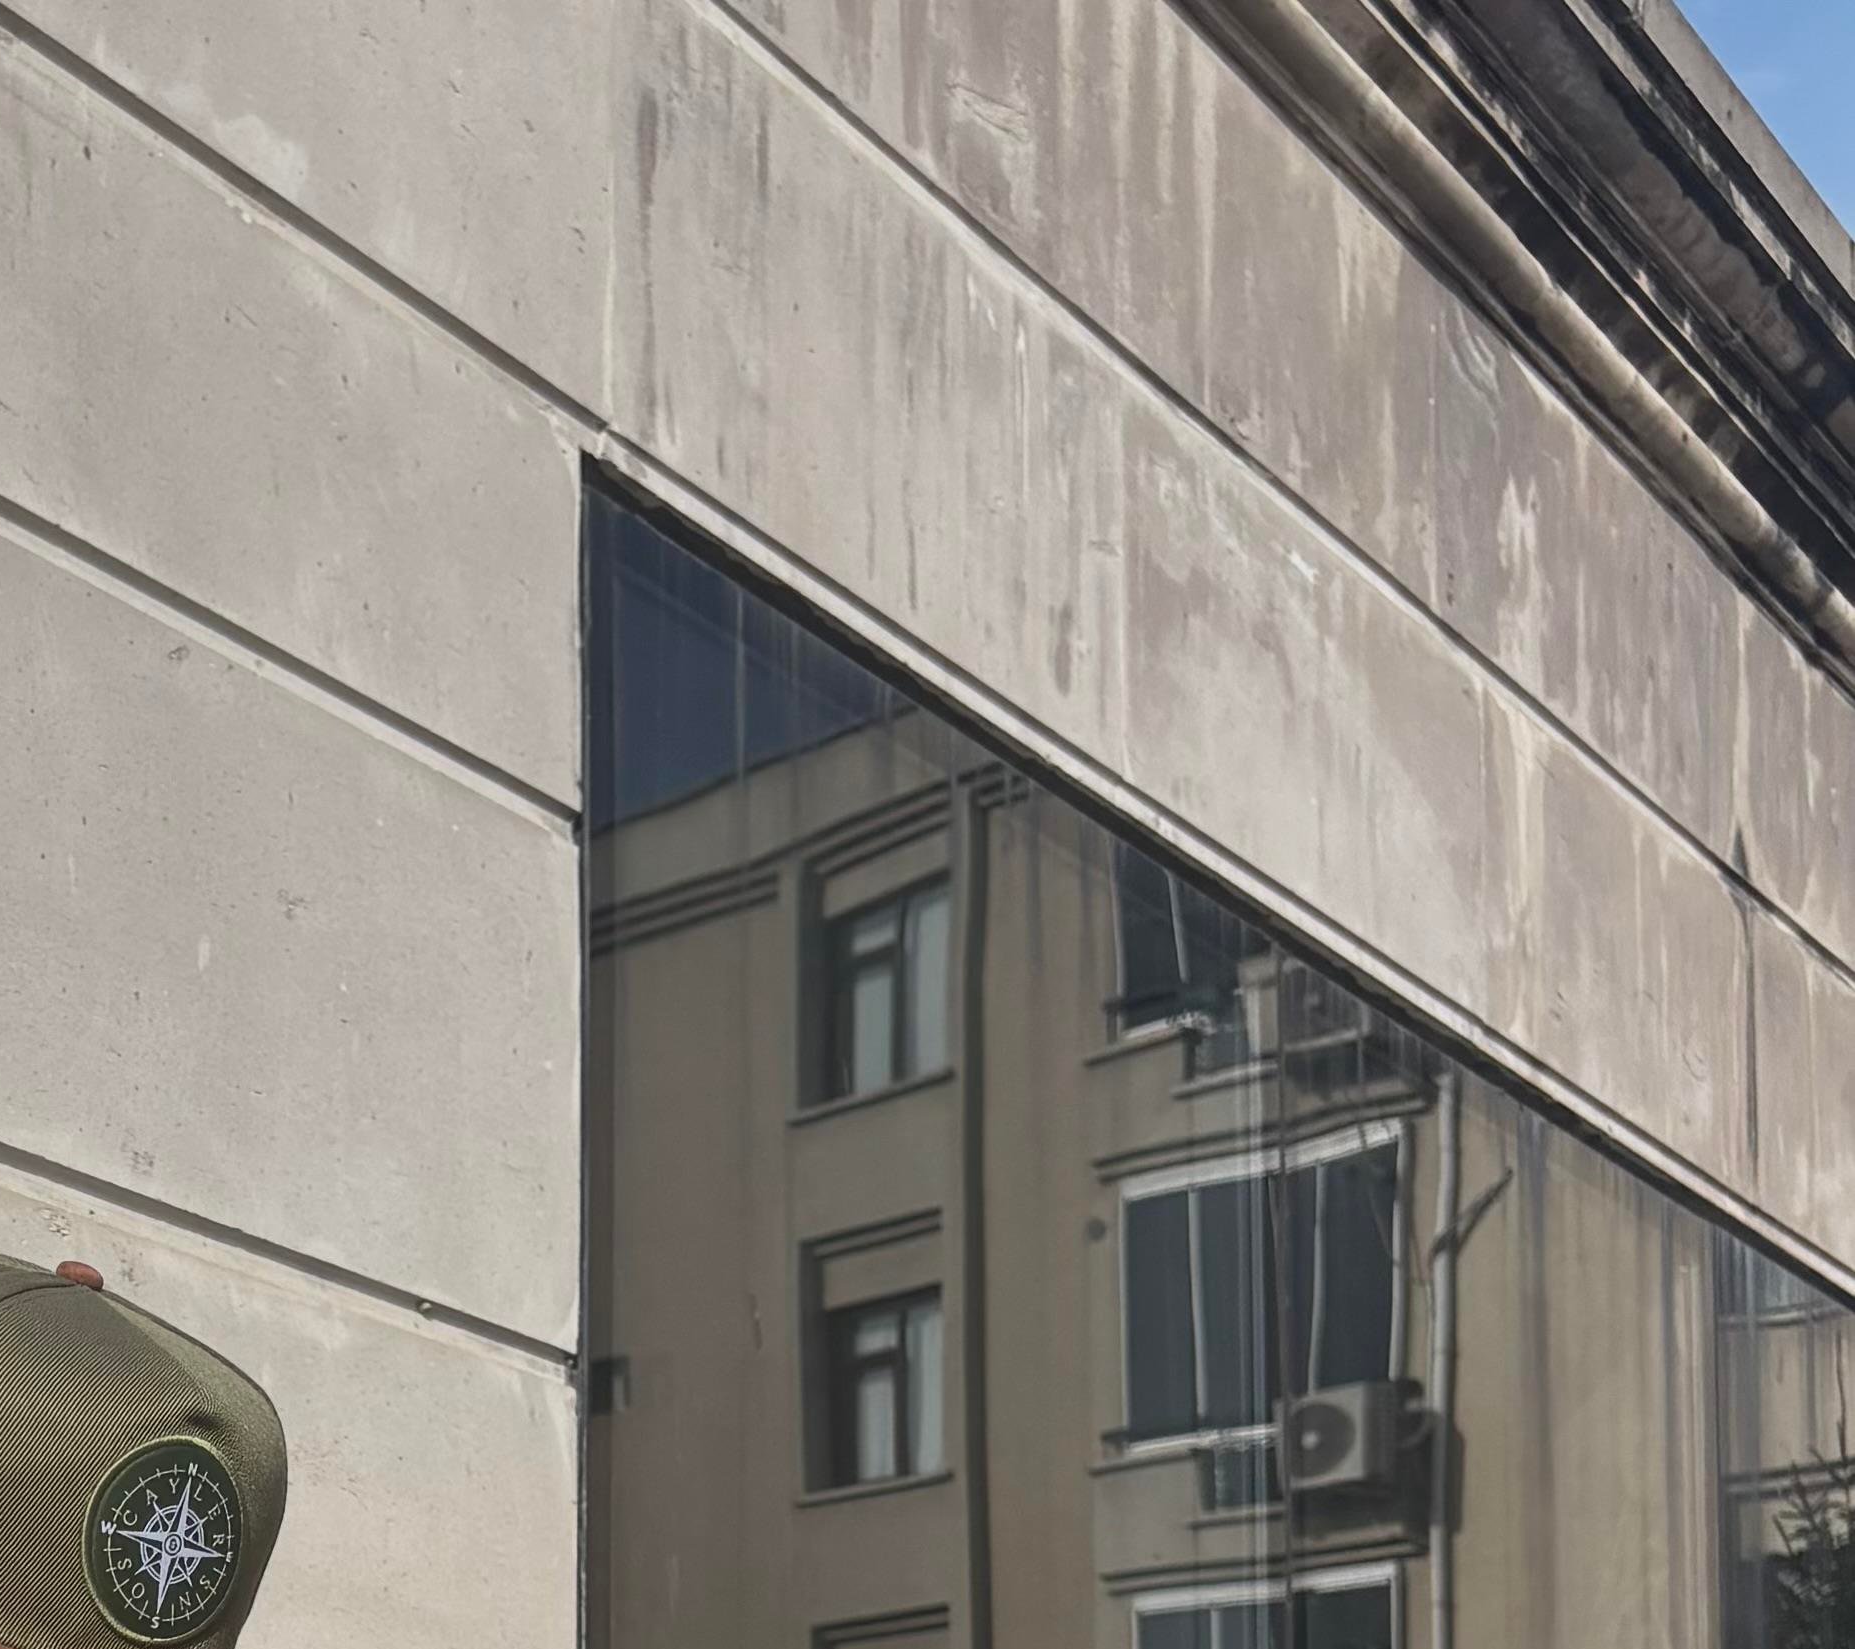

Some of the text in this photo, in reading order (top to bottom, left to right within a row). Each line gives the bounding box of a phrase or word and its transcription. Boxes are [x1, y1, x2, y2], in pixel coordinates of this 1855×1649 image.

[188, 1462, 198, 1476] N
[122, 1477, 225, 1547] CAYLER
[101, 1520, 117, 1535] W
[117, 1557, 212, 1611] SONS
[150, 1616, 160, 1629] S
